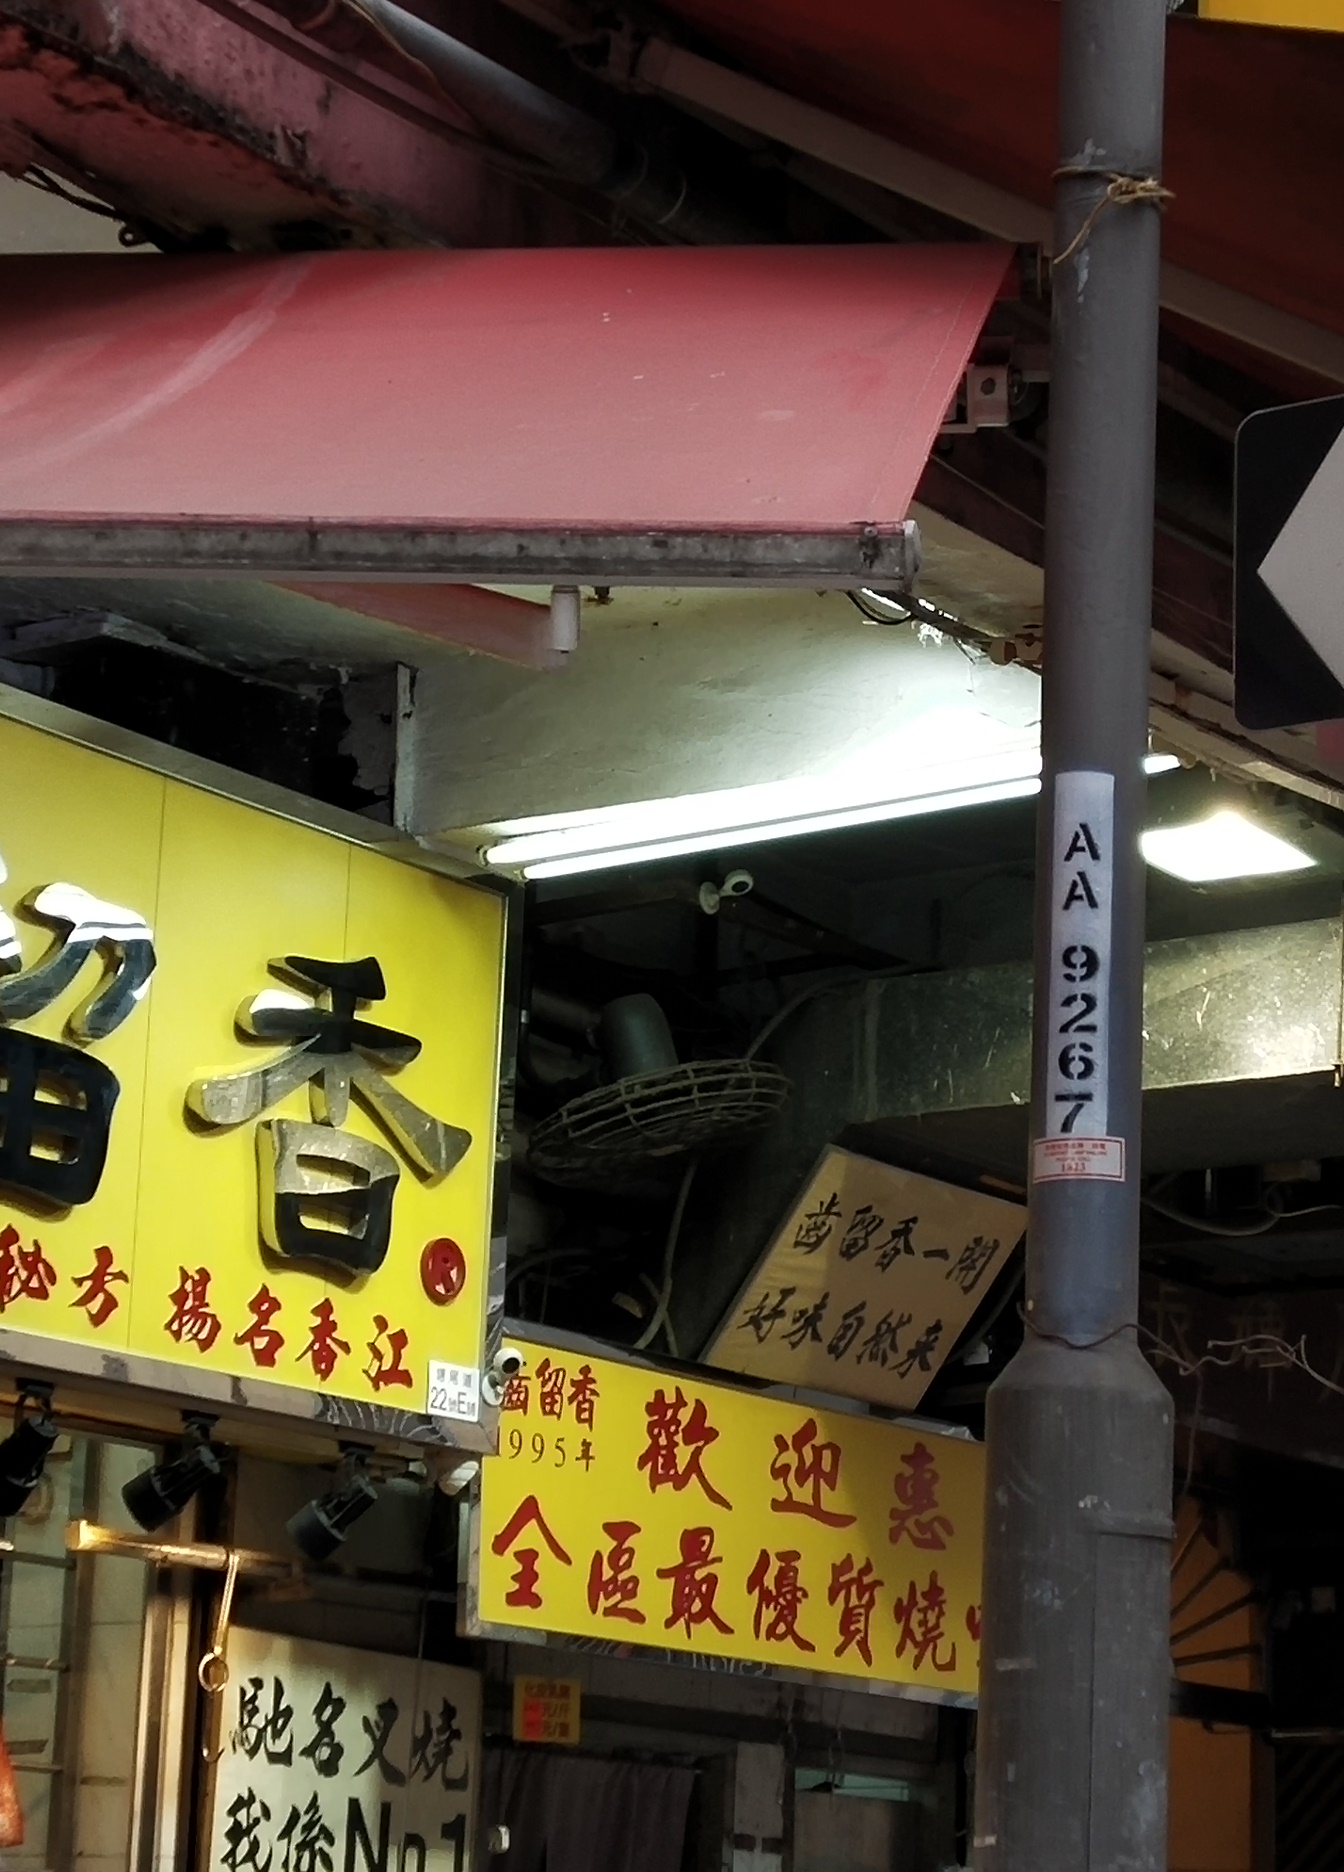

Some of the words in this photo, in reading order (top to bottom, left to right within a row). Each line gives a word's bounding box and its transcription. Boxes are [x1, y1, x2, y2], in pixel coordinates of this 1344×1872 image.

[1062, 822, 1101, 911] AA
[1054, 944, 1100, 1134] 9267
[163, 1264, 414, 1392] 揚名香江
[228, 1675, 470, 1791] 馳名叉燒
